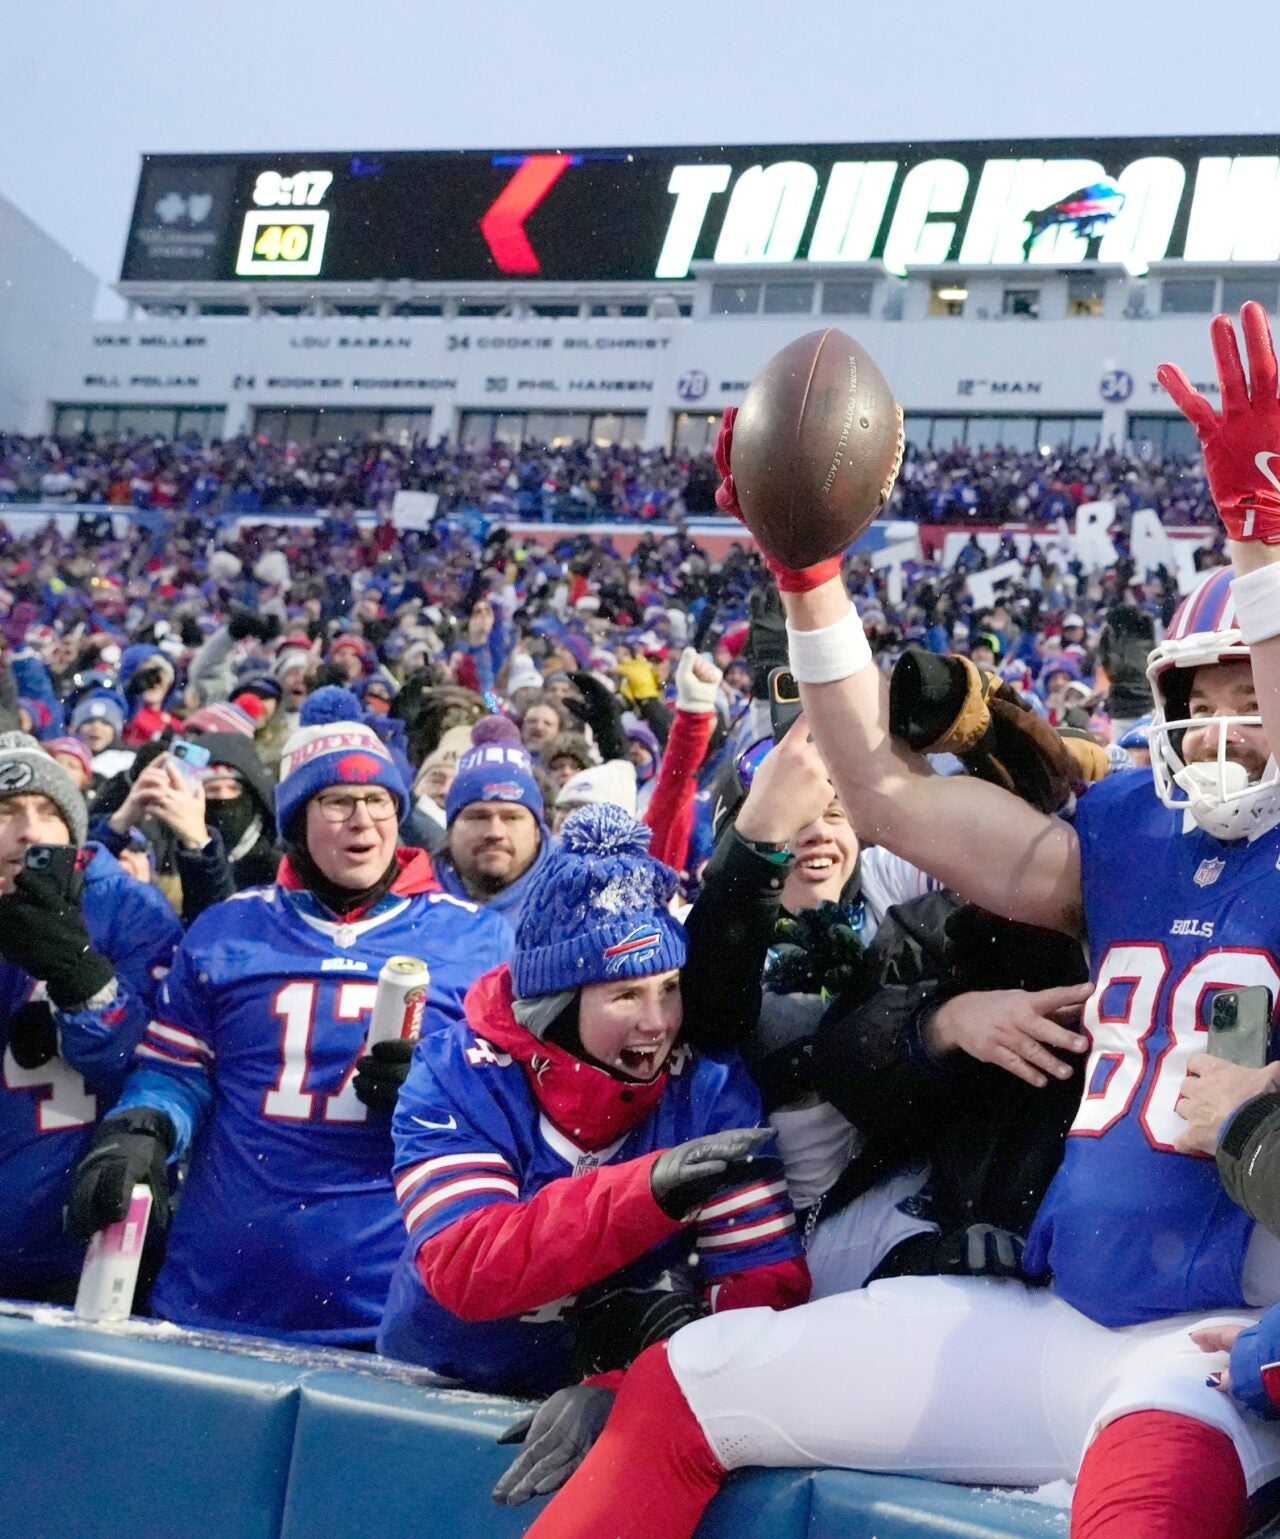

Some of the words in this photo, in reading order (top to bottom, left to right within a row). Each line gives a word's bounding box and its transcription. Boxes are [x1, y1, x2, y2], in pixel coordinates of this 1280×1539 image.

[253, 171, 333, 206] 8:17
[255, 225, 308, 260] 40
[991, 382, 1041, 393] MAN
[838, 398, 856, 447] FOOTBALL
[821, 451, 844, 493] LEAGUE
[1169, 919, 1215, 938] BILLS
[260, 979, 380, 1122] 17
